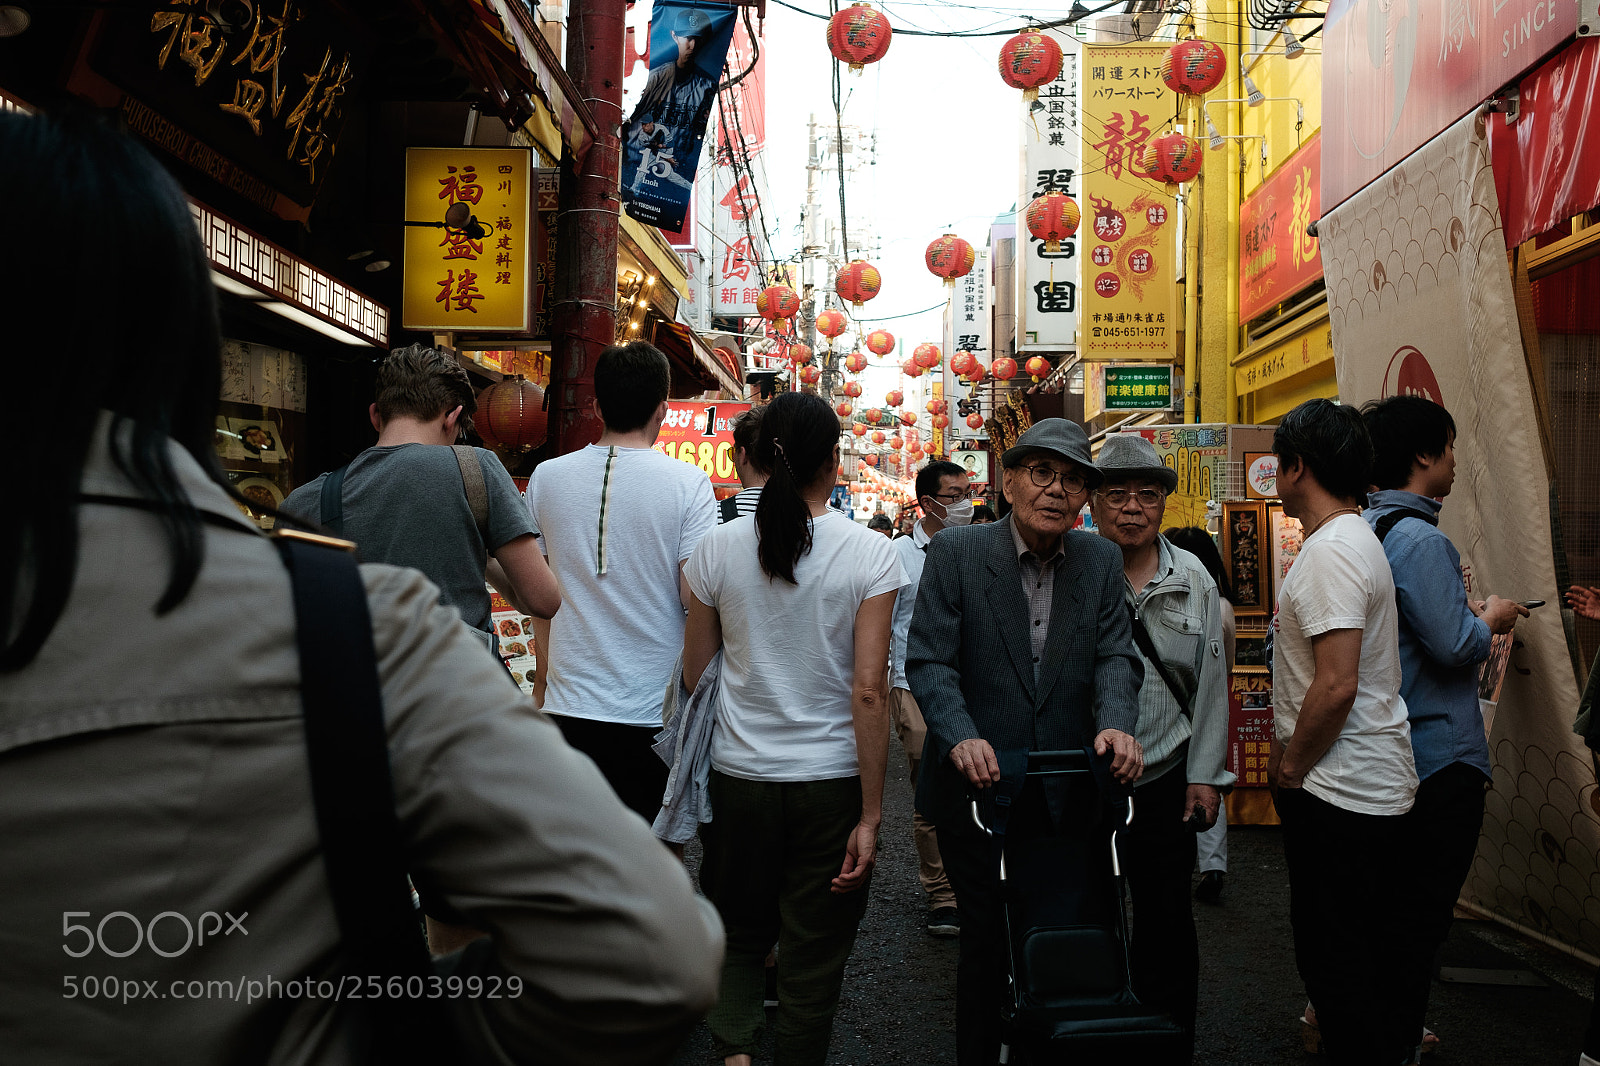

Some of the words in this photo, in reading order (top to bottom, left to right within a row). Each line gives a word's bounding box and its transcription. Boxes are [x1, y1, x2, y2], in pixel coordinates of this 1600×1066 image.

[1502, 0, 1557, 58] SINCE
[1093, 86, 1165, 100] パワーストーン
[636, 147, 675, 179] 15
[1096, 215, 1123, 228] 風水
[1289, 165, 1318, 272] 龍
[1097, 227, 1121, 236] グッズ
[1095, 247, 1110, 255] 中華
[721, 287, 759, 304] 新館
[1092, 312, 1165, 323] 市場通り朱雀店
[1103, 326, 1165, 337] 045-651-1977
[1106, 384, 1170, 397] 康楽健康館
[661, 409, 694, 428] なび
[665, 441, 738, 480] 1680
[1231, 675, 1272, 693] 風水
[1245, 742, 1270, 754] 開運
